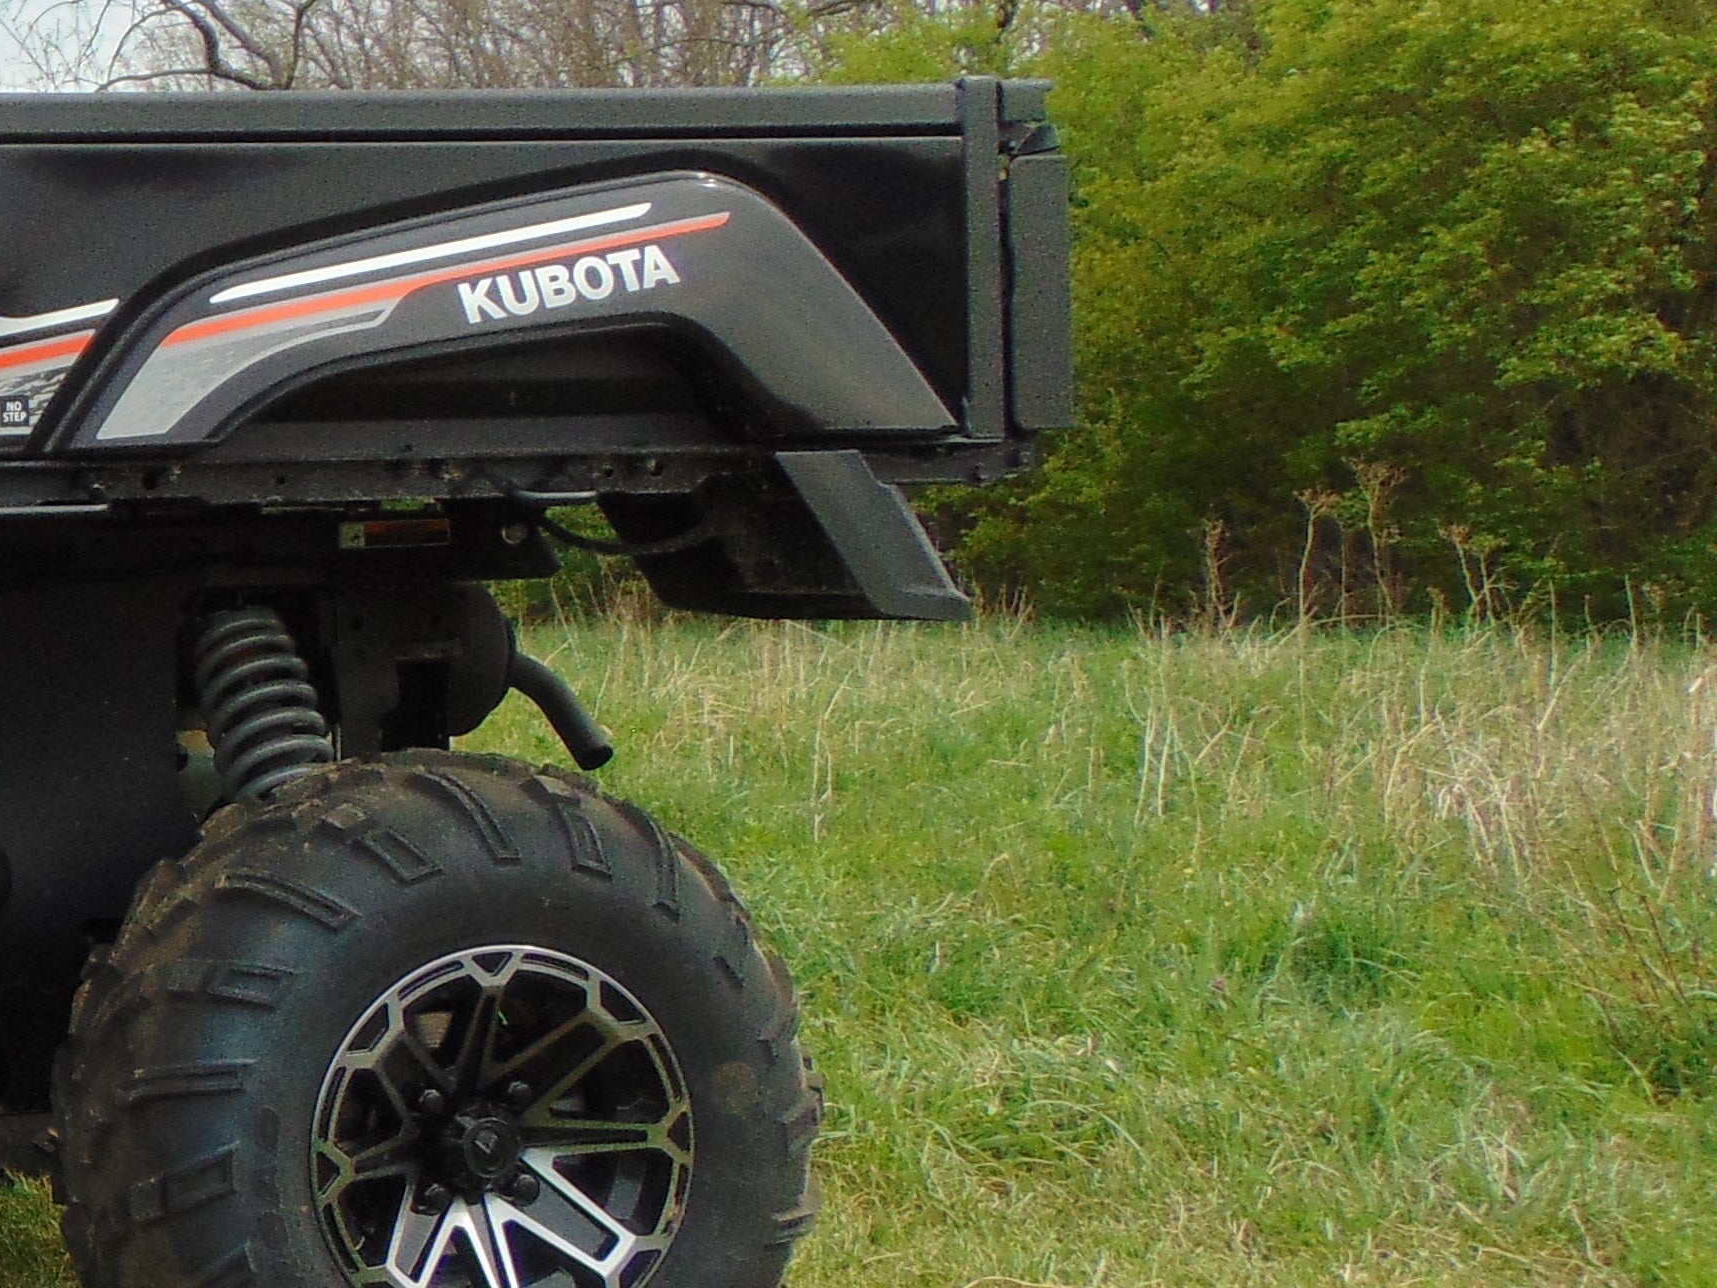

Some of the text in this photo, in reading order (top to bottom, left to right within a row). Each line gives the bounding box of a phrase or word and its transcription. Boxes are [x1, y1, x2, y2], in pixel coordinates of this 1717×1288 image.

[457, 245, 681, 324] KUBOTA
[6, 400, 22, 412] NO
[2, 411, 27, 423] STEP
